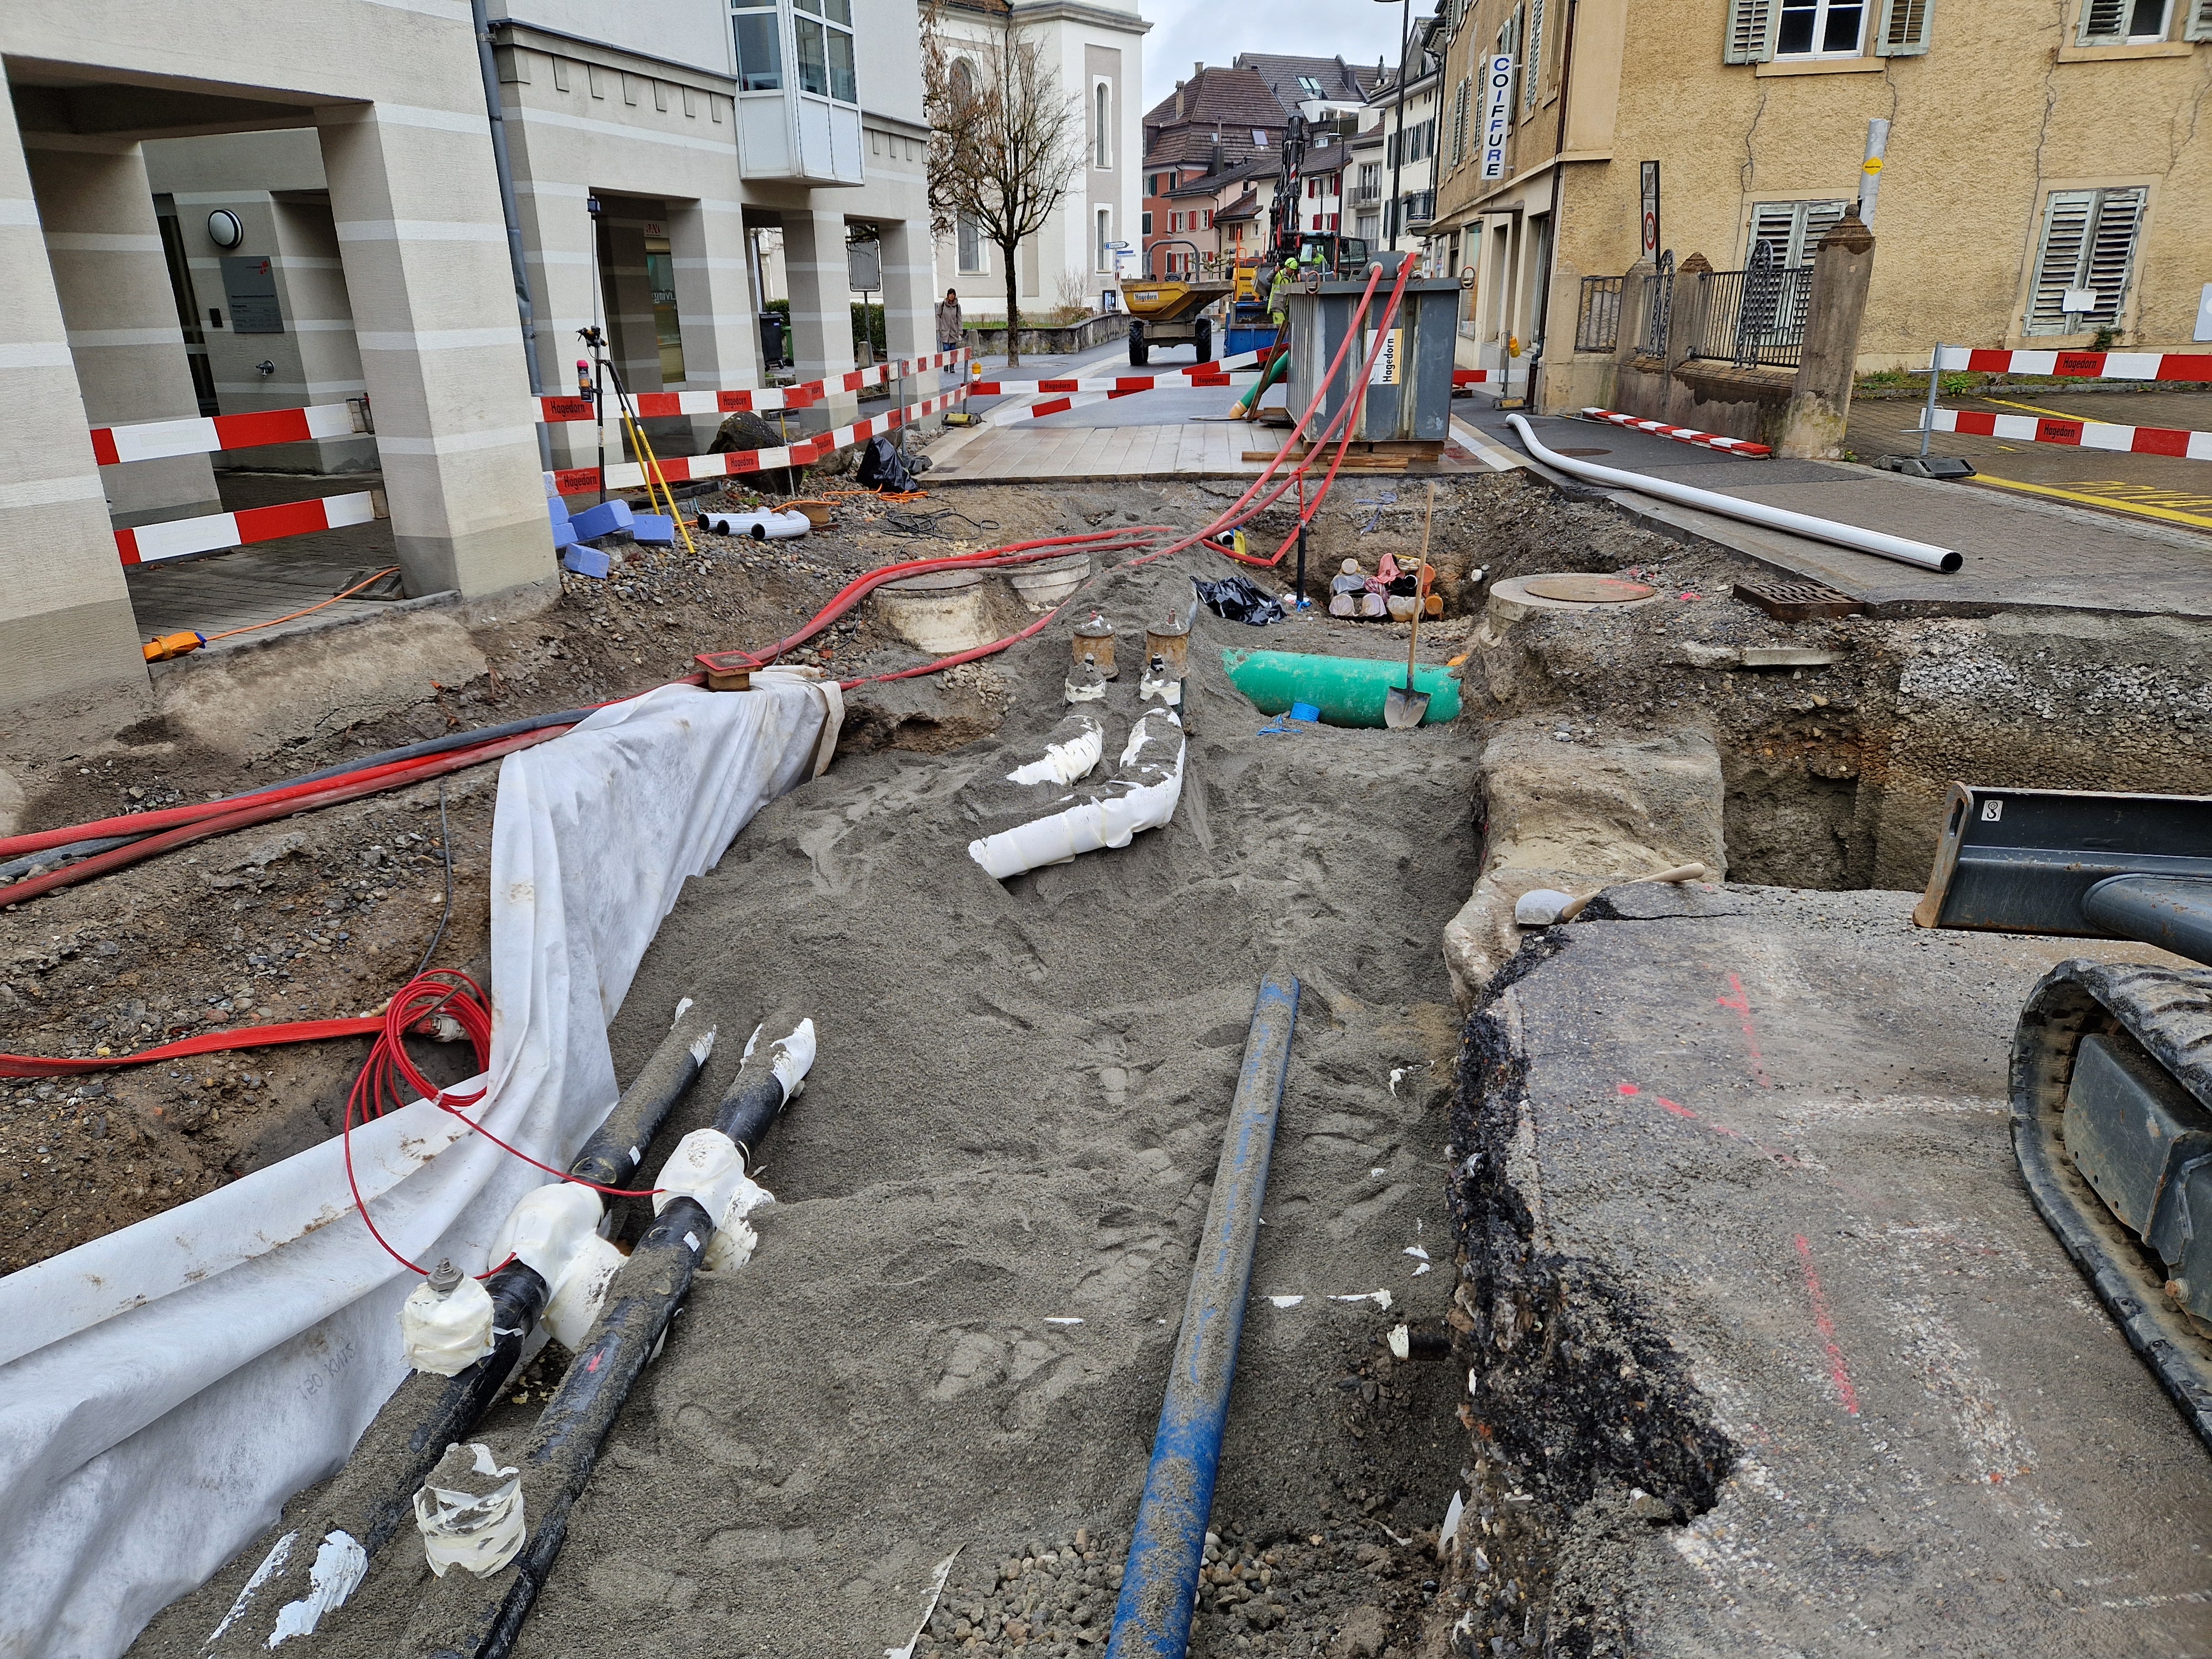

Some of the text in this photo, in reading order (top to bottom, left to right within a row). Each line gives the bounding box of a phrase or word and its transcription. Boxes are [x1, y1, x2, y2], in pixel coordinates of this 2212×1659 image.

[1486, 58, 1510, 176] COIFFURE
[1647, 223, 1652, 238] 30
[1135, 293, 1157, 302] Hagedorn
[1383, 338, 1396, 382] Hagedorn
[2063, 356, 2097, 372] Hagedorn
[1045, 382, 1071, 390] Hagedorn
[550, 400, 585, 417] Hagedorn
[723, 395, 747, 409] Hagedorn
[2044, 423, 2075, 439] Hagedorn
[730, 456, 754, 469] Hagedorn
[564, 473, 597, 490] Hagedorn
